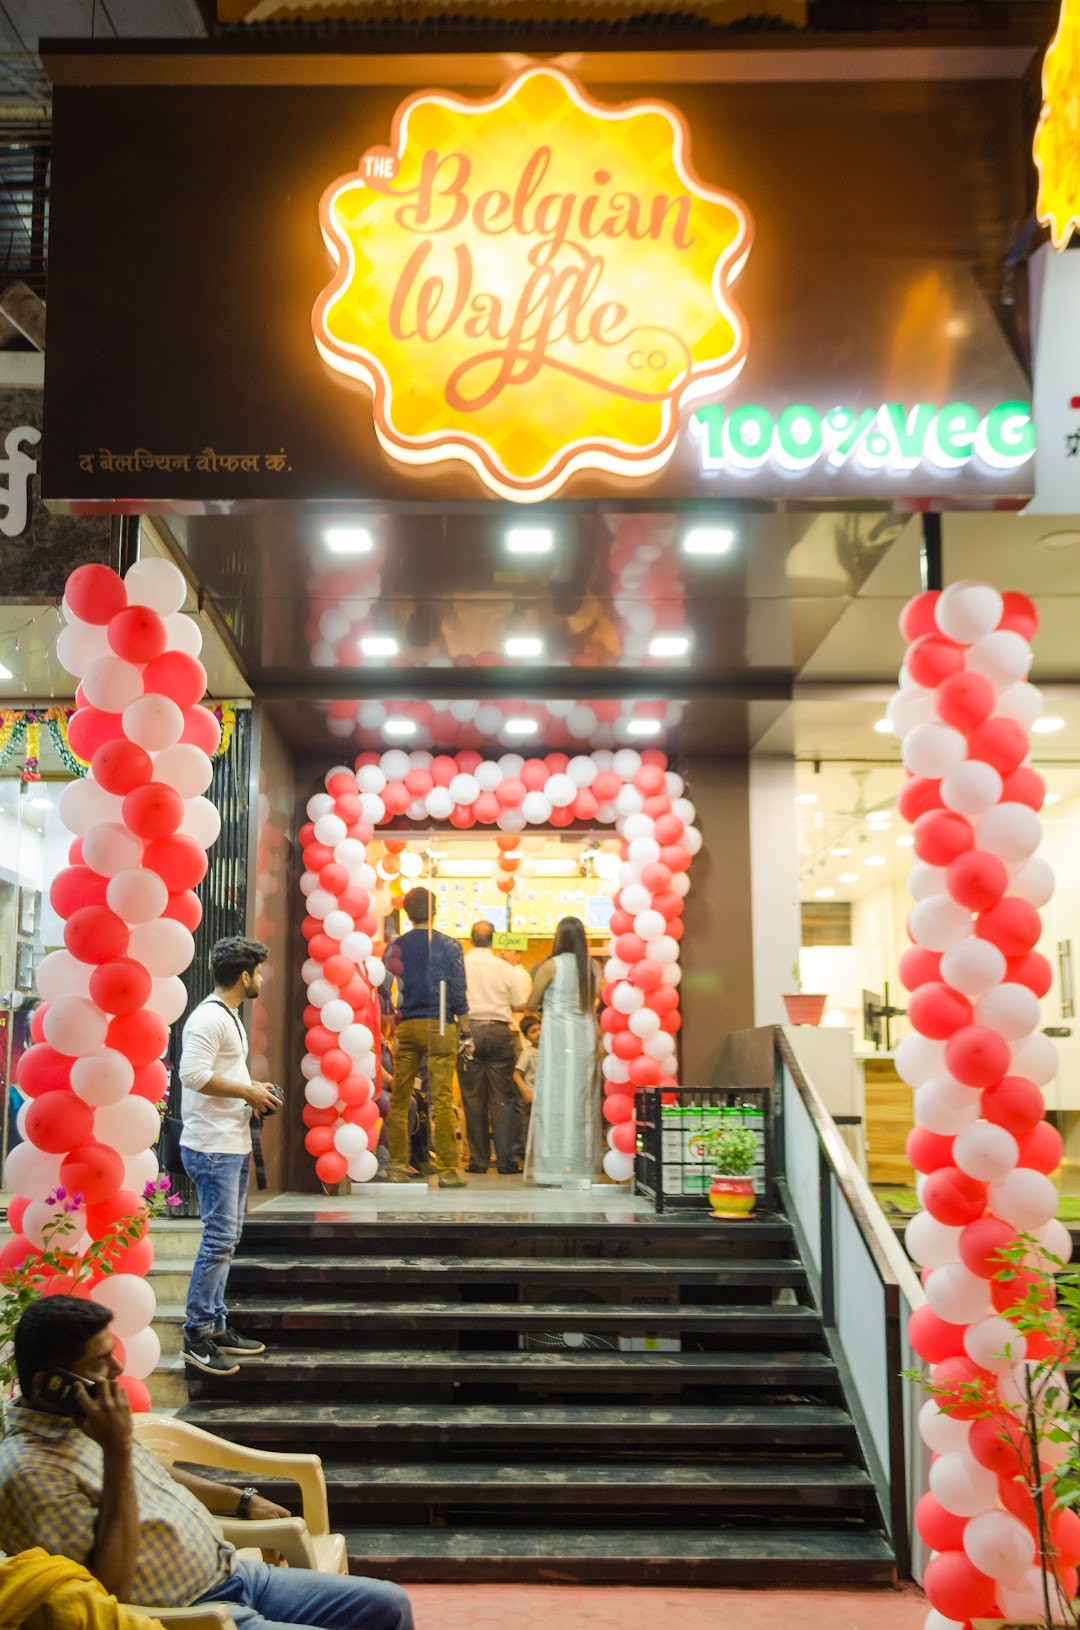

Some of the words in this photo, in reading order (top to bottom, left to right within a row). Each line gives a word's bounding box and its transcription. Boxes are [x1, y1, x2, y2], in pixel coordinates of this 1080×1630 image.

[364, 156, 394, 179] THE
[396, 145, 696, 262] Belgian
[388, 240, 692, 412] Waffle
[627, 350, 667, 370] CO
[79, 455, 95, 473] द
